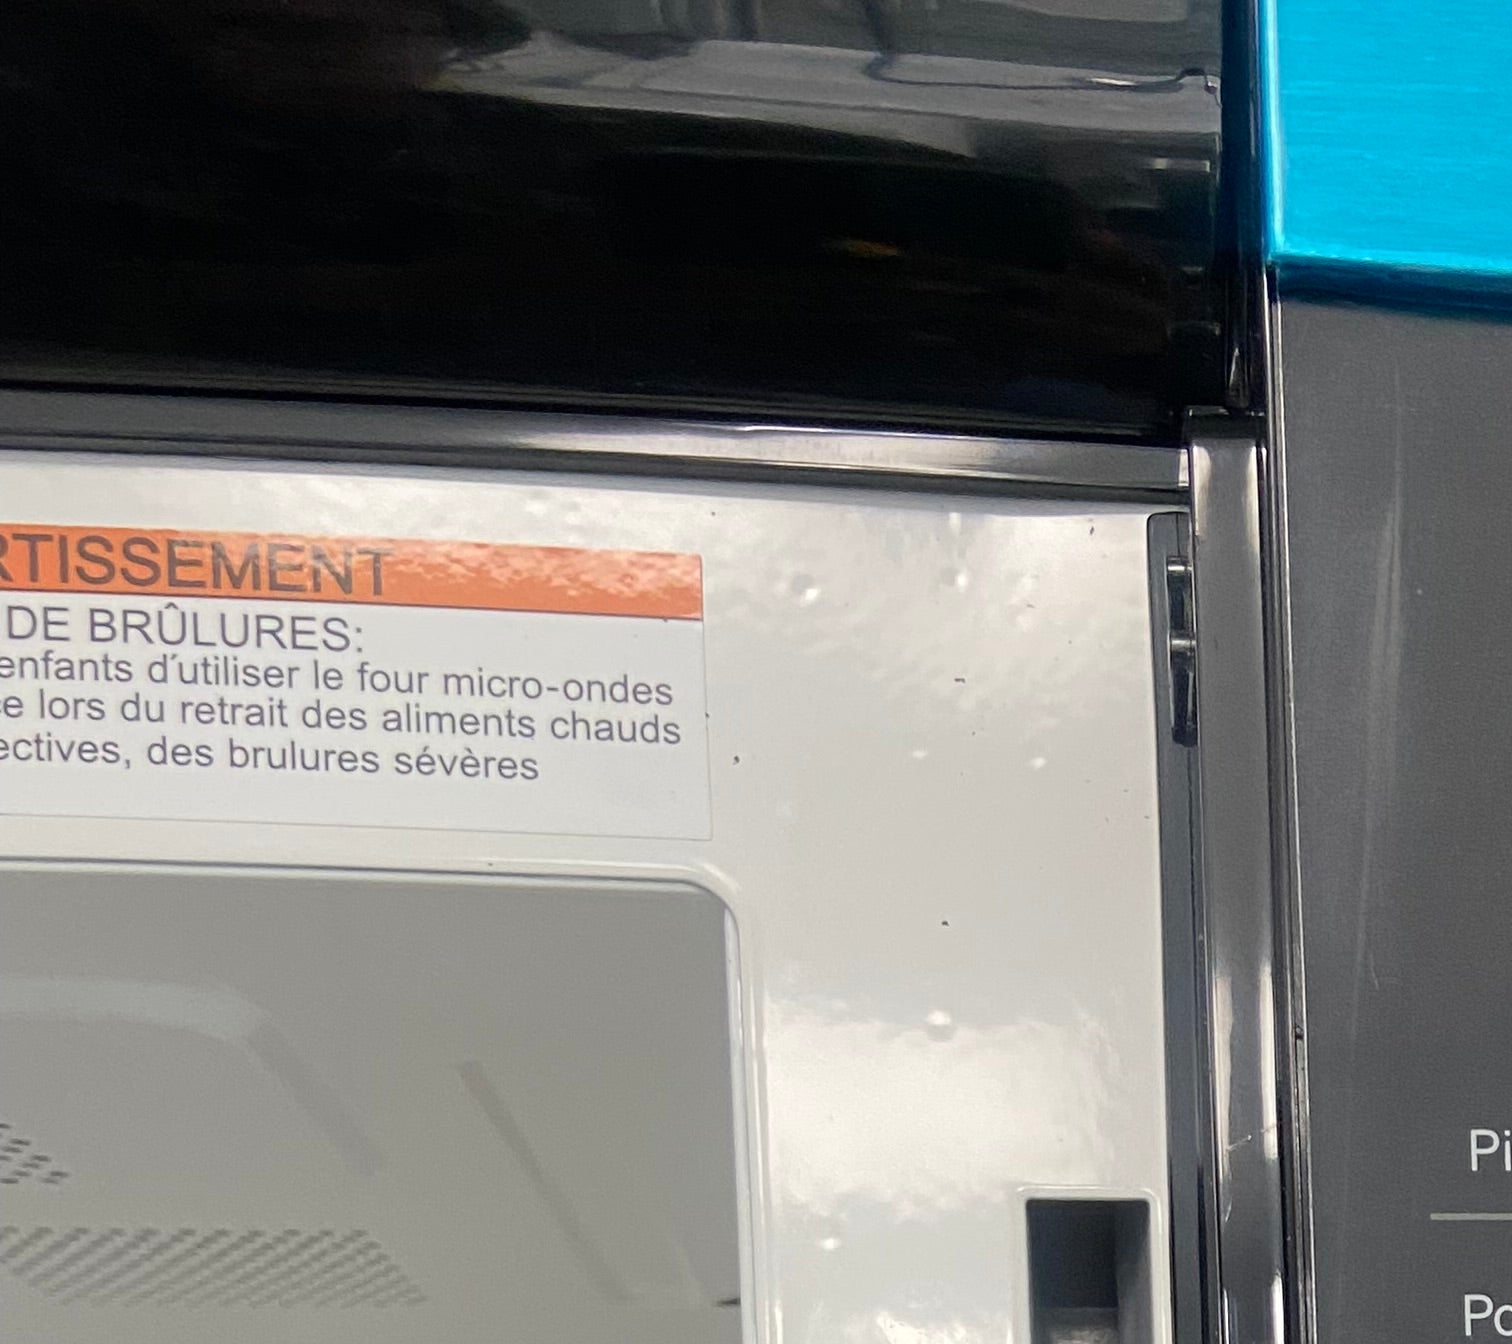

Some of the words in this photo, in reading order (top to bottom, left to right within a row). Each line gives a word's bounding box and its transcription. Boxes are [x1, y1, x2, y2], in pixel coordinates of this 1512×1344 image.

[7, 605, 71, 642] DE
[89, 602, 363, 653] BRÛLURES:
[0, 650, 133, 682] enfants
[313, 659, 344, 691] le
[357, 662, 428, 693] four
[443, 667, 673, 706] micro-ondes
[0, 694, 24, 719] e
[40, 688, 105, 721] lors
[121, 692, 165, 723] du
[181, 696, 288, 728] retrait
[302, 700, 367, 731] des
[383, 703, 536, 738] aliments
[550, 711, 681, 745] chauds
[147, 736, 214, 767] des
[229, 738, 380, 773] brulures
[394, 746, 539, 780] sévères
